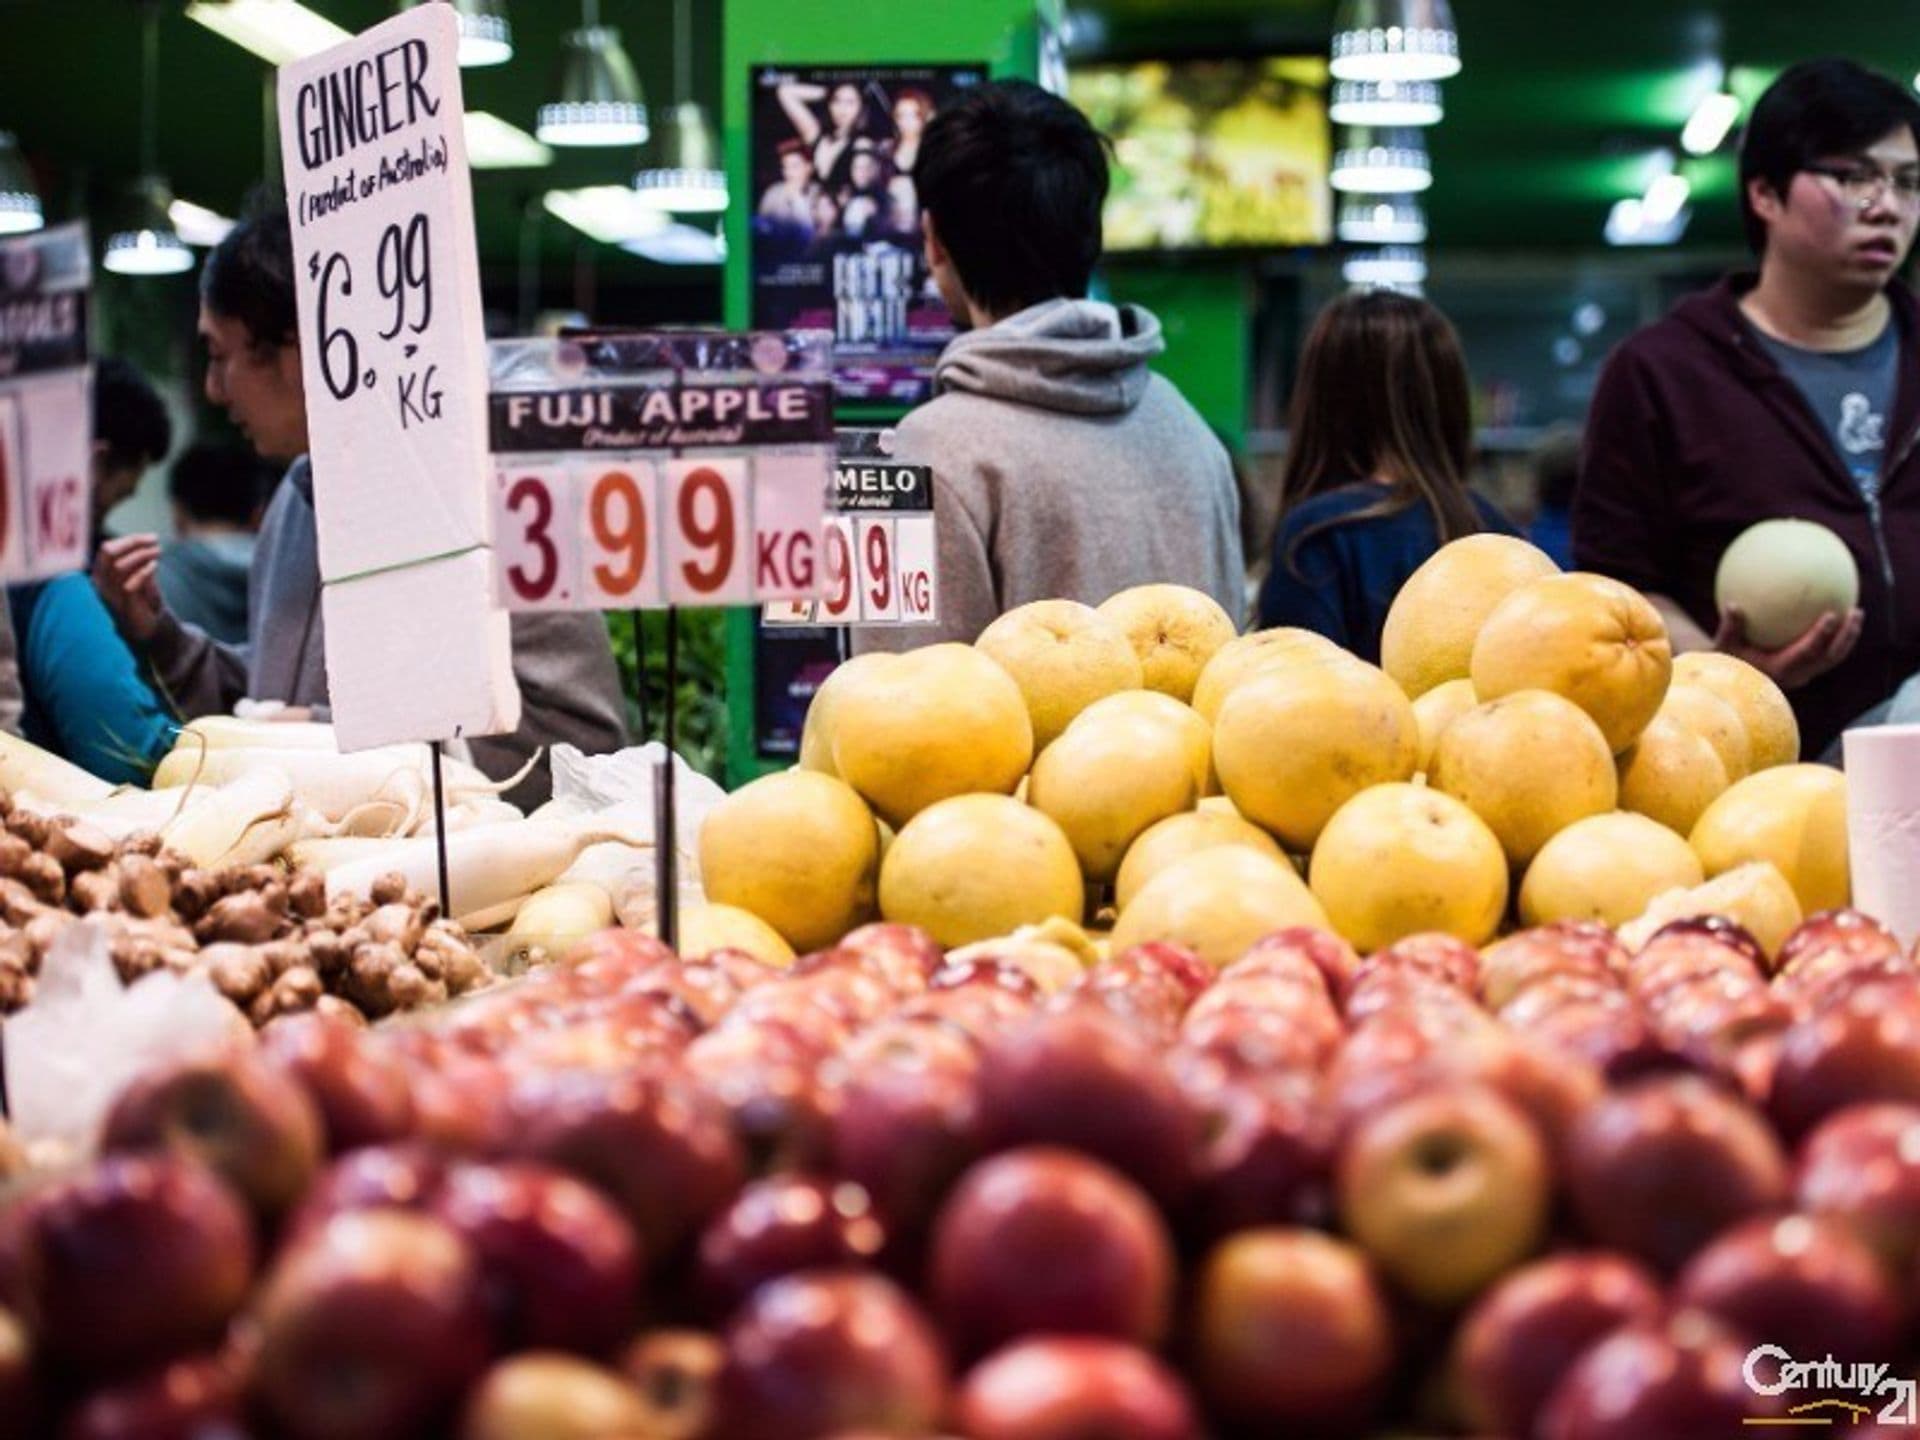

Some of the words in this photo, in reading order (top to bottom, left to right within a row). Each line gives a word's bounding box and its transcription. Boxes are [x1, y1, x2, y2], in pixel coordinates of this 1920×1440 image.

[297, 38, 440, 170] GINGER
[397, 364, 443, 429] KG
[508, 394, 612, 428] FUJI
[641, 387, 808, 425] APPLE
[834, 469, 917, 492] MELO
[756, 529, 814, 588] KG
[901, 571, 931, 613] KG
